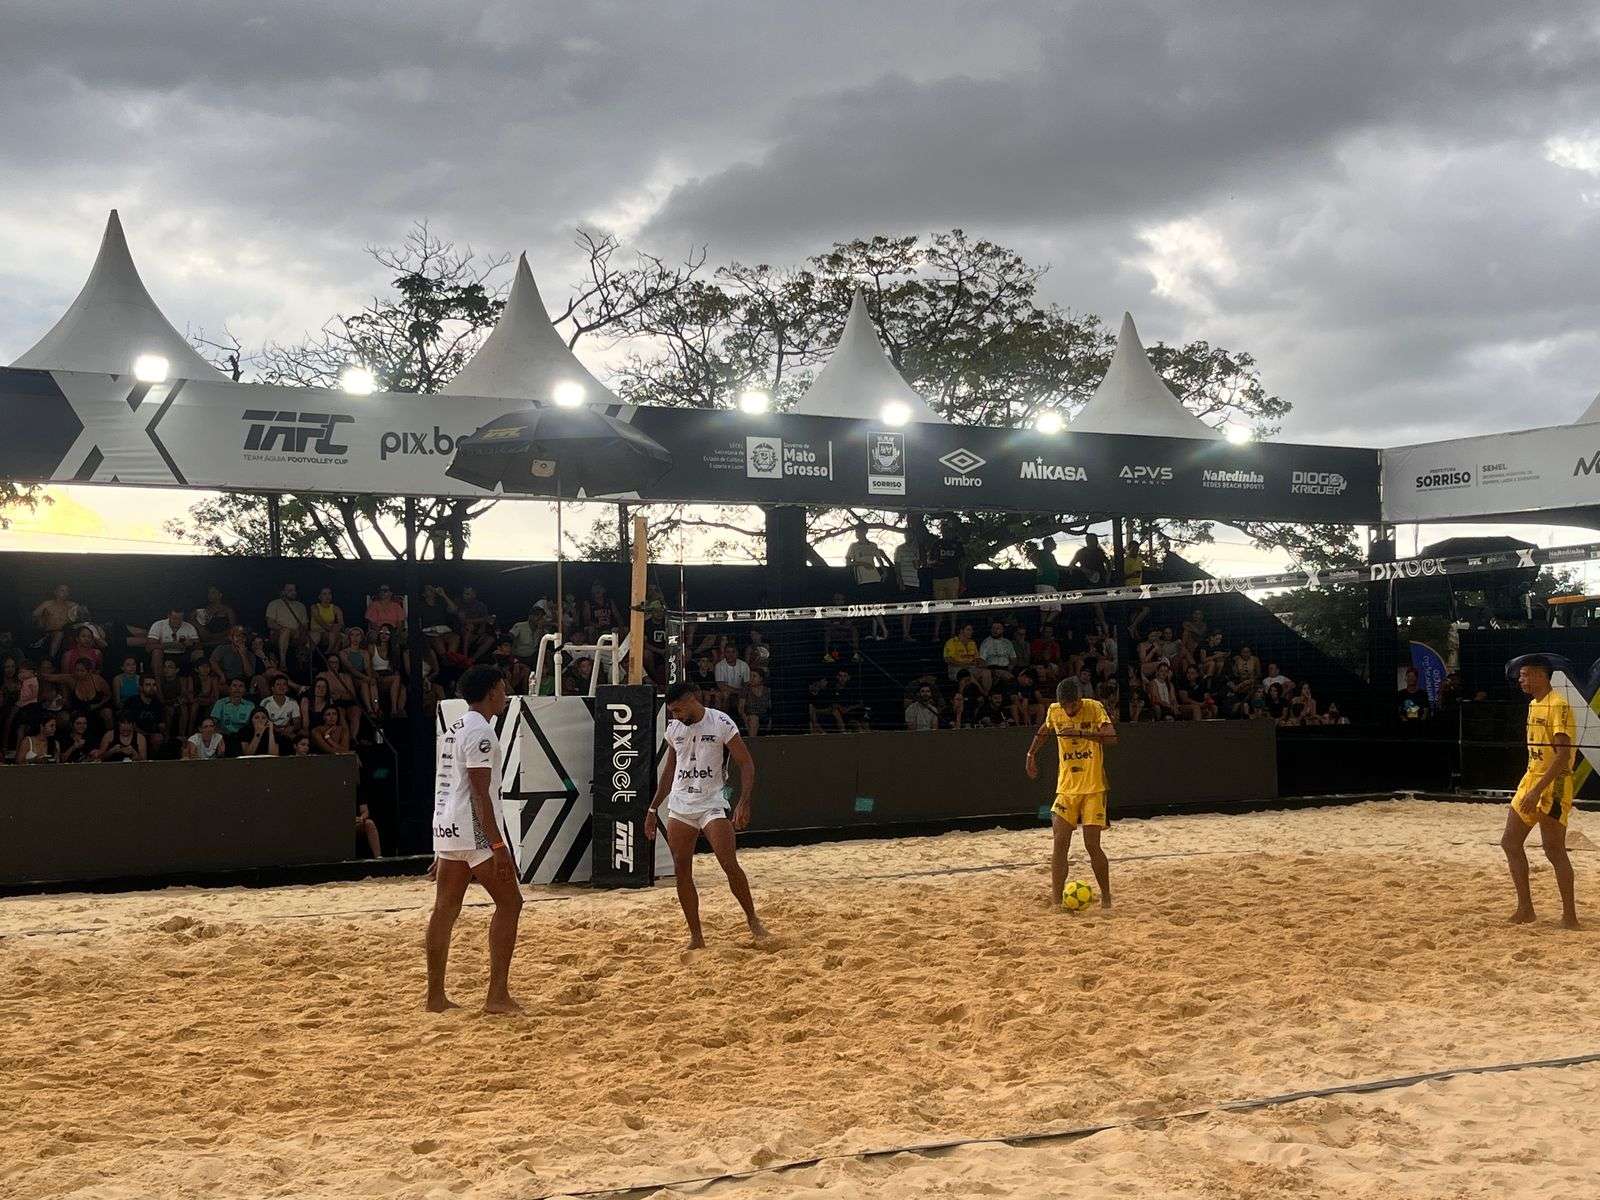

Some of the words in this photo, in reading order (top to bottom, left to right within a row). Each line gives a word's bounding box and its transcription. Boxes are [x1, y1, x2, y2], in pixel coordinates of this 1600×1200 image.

[380, 425, 471, 461] pix.b
[242, 454, 263, 462] TEAM
[287, 456, 334, 465] FOOTVOLLEY
[784, 448, 816, 463] Mato
[784, 462, 828, 477] Grosso
[1119, 465, 1174, 480] APVS
[1202, 469, 1264, 483] NaRedinha
[872, 480, 902, 488] SORRISO
[944, 475, 982, 487] umbro
[1415, 471, 1472, 488] SORRISO
[1291, 484, 1341, 496] KRIGUER
[606, 703, 639, 802] pixbet
